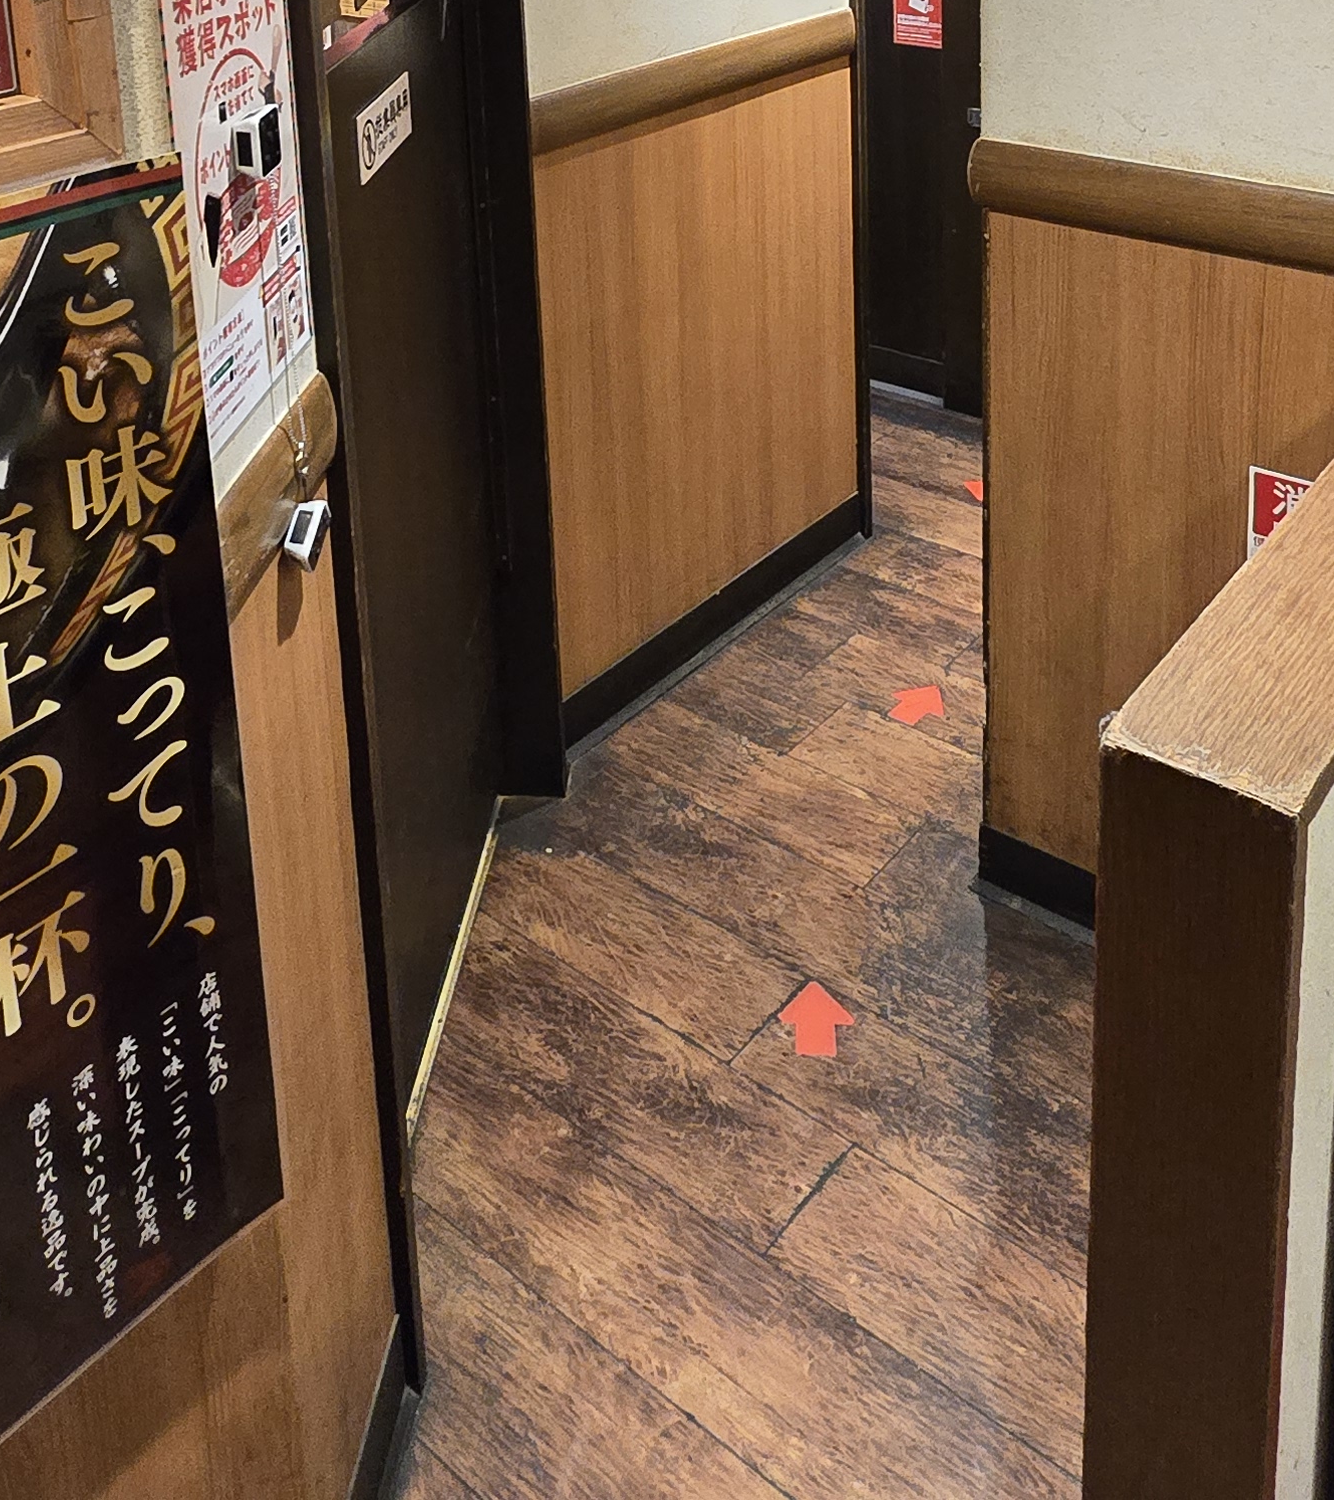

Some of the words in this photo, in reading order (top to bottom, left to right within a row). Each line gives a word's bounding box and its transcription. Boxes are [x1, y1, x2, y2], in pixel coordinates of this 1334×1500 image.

[58, 242, 214, 949] こい味、こってり、
[115, 1034, 161, 1249] 表現したスープが完成。
[197, 971, 230, 1097] 店舗で人気の
[25, 1097, 74, 1298] 感じられる逸品です。
[70, 1063, 119, 1319] 深い味わいの中に上品さを
